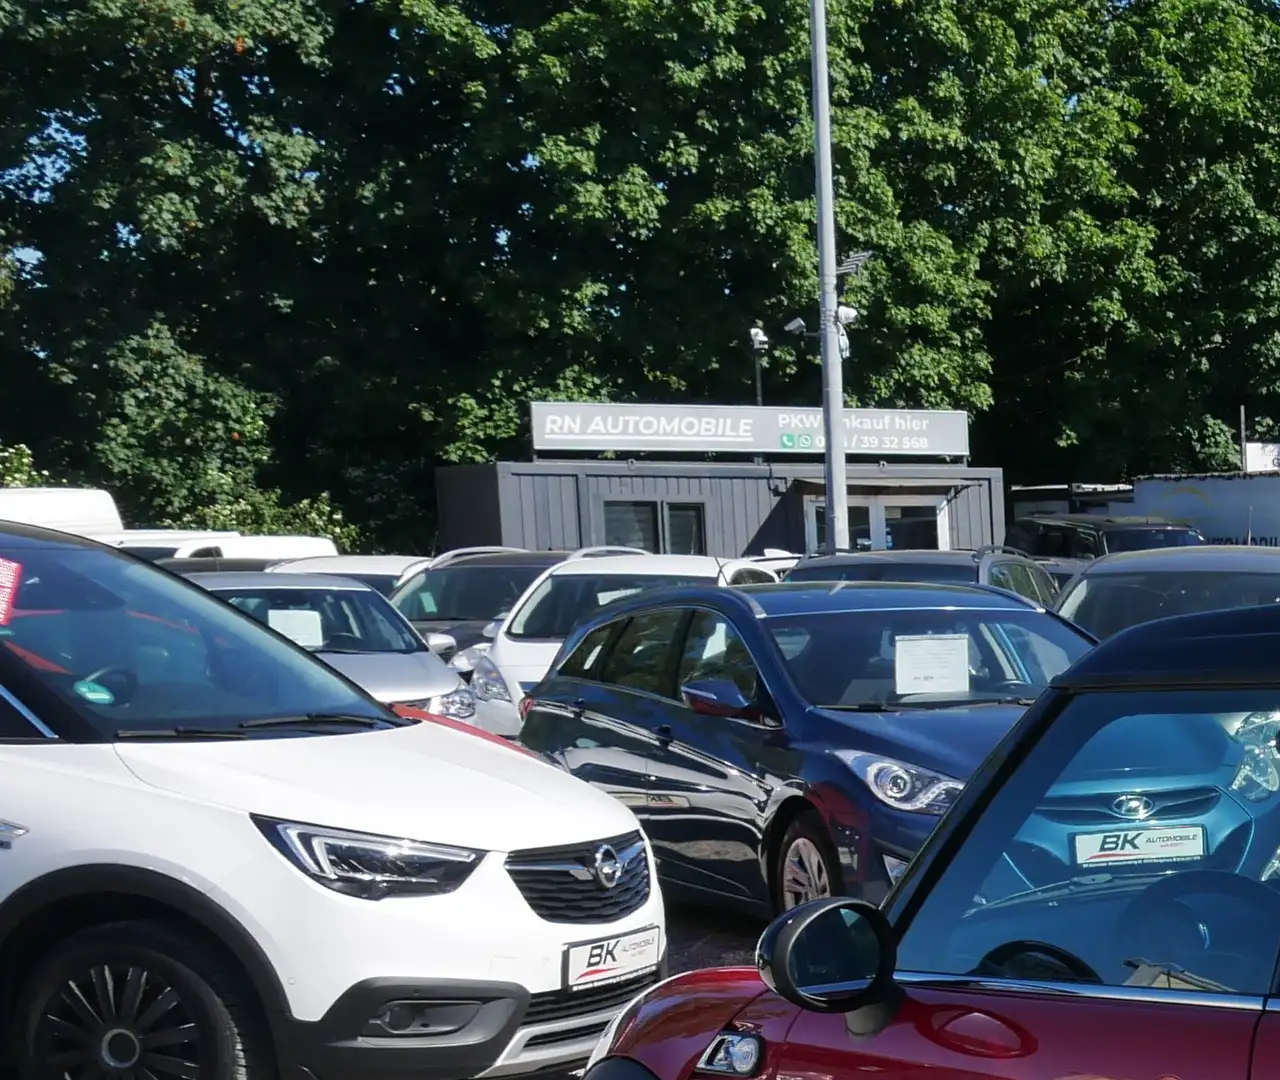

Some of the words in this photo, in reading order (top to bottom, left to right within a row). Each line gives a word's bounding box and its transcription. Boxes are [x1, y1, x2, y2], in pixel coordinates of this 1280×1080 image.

[544, 414, 581, 435] RN
[586, 414, 754, 437] AUTOMOBILE
[777, 413, 823, 429] PKW
[842, 413, 891, 430] nkauf
[894, 414, 930, 431] hier
[859, 435, 880, 448] 39
[881, 436, 899, 449] 32
[1098, 832, 1145, 852] BK
[1145, 834, 1199, 844] AUTOMOBILE
[586, 939, 621, 969] BK
